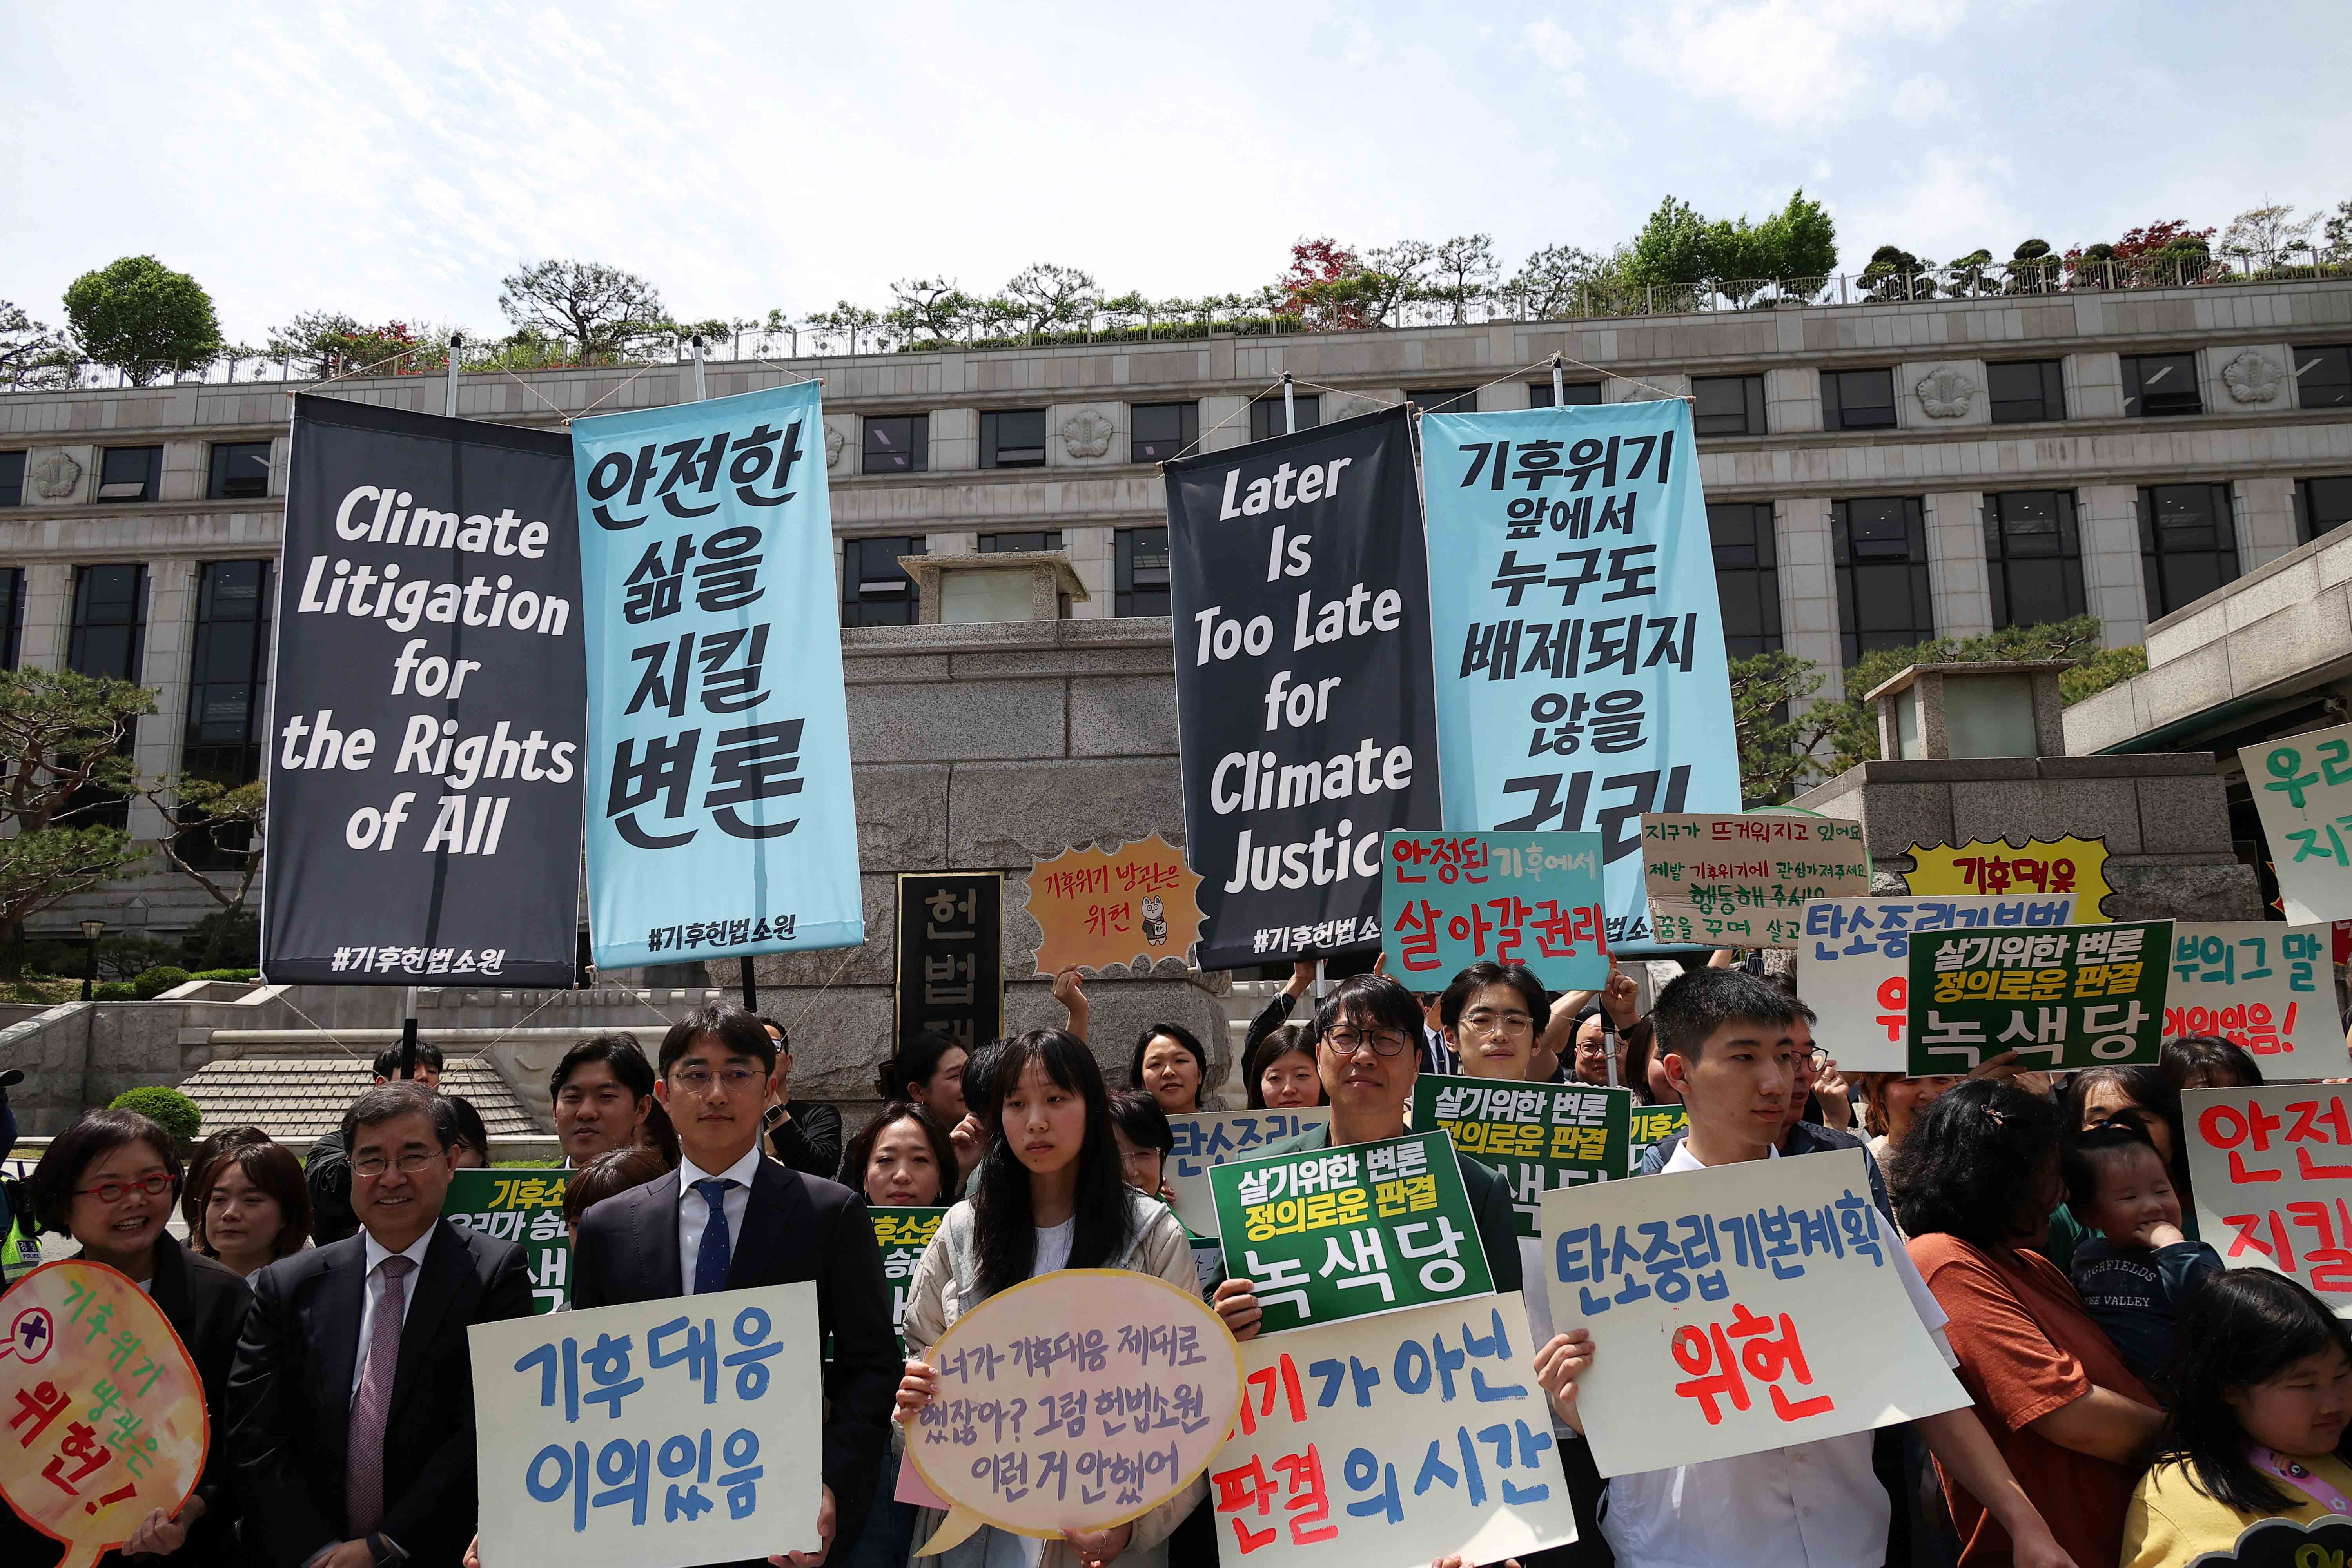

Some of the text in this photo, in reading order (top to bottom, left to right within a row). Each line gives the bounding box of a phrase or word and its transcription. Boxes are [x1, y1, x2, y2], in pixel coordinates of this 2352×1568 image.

[587, 418, 803, 532] 안전한
[1219, 456, 1351, 522] Later
[1459, 430, 1674, 491] 기후위기
[335, 484, 550, 559] Climate
[1505, 491, 1635, 541] 앞에서
[622, 526, 765, 625] 삶을
[1266, 524, 1312, 583] Is
[1491, 543, 1657, 608] 누구도
[297, 555, 570, 637] Litigation
[1194, 582, 1402, 667] Too Late
[391, 638, 481, 700] for
[623, 622, 770, 718] 지킬
[1459, 612, 1697, 681] 배제되지
[1264, 670, 1340, 732] for
[1527, 691, 1647, 758] 않을
[281, 709, 577, 789] the Rights
[1210, 737, 1413, 816] Climate
[606, 717, 805, 849] 변론
[345, 791, 510, 856] of All
[1646, 821, 1860, 843] 지구가 뜨거워지고 있어요
[2285, 815, 2352, 866] 지
[1044, 862, 1180, 900] 기후위기 방관은
[1223, 818, 1407, 895] Justic
[1392, 837, 1596, 884] 안정된 기후에서
[1649, 861, 1685, 881] 제발
[1689, 860, 1769, 880] 기후위기에
[1953, 855, 2076, 895] 기후대응
[1084, 902, 1131, 937] 위헌
[1688, 883, 1764, 915] 행동해
[1702, 918, 1750, 937] 꾸며
[332, 945, 505, 976] #기후헌법소원
[647, 913, 797, 951] #기후헌법소원
[1253, 916, 1382, 954] #기후헌법소
[1935, 929, 2145, 971] 살기위한 변론
[2282, 934, 2323, 992] 말
[1934, 962, 2143, 1003] 정의로운 판결
[1922, 1000, 2150, 1069] 녹색당
[1434, 1086, 1608, 1126] 살기위한 변론
[1436, 1120, 1545, 1157] 정의로운
[1550, 1127, 1608, 1161] 판결
[1237, 1141, 1428, 1207] 살기위한 변론
[871, 1215, 943, 1246] 후소송
[1245, 1178, 1438, 1242] 정의로운 판결
[1243, 1216, 1466, 1319] 녹색당
[2104, 1296, 2150, 1307] VALLEY
[62, 1279, 165, 1397] 기후위기
[940, 1325, 1207, 1384] 너가 기후대응 제대로
[1672, 1303, 1835, 1425] 위헌
[1226, 1307, 1528, 1441] 기가 아닌
[1033, 1389, 1087, 1437] 그럼
[1094, 1383, 1210, 1438] 헌법소원
[526, 1428, 763, 1533] 이의있음
[971, 1451, 1029, 1503] 이런
[1036, 1450, 1067, 1501] 거
[1415, 1418, 1553, 1507] 시간
